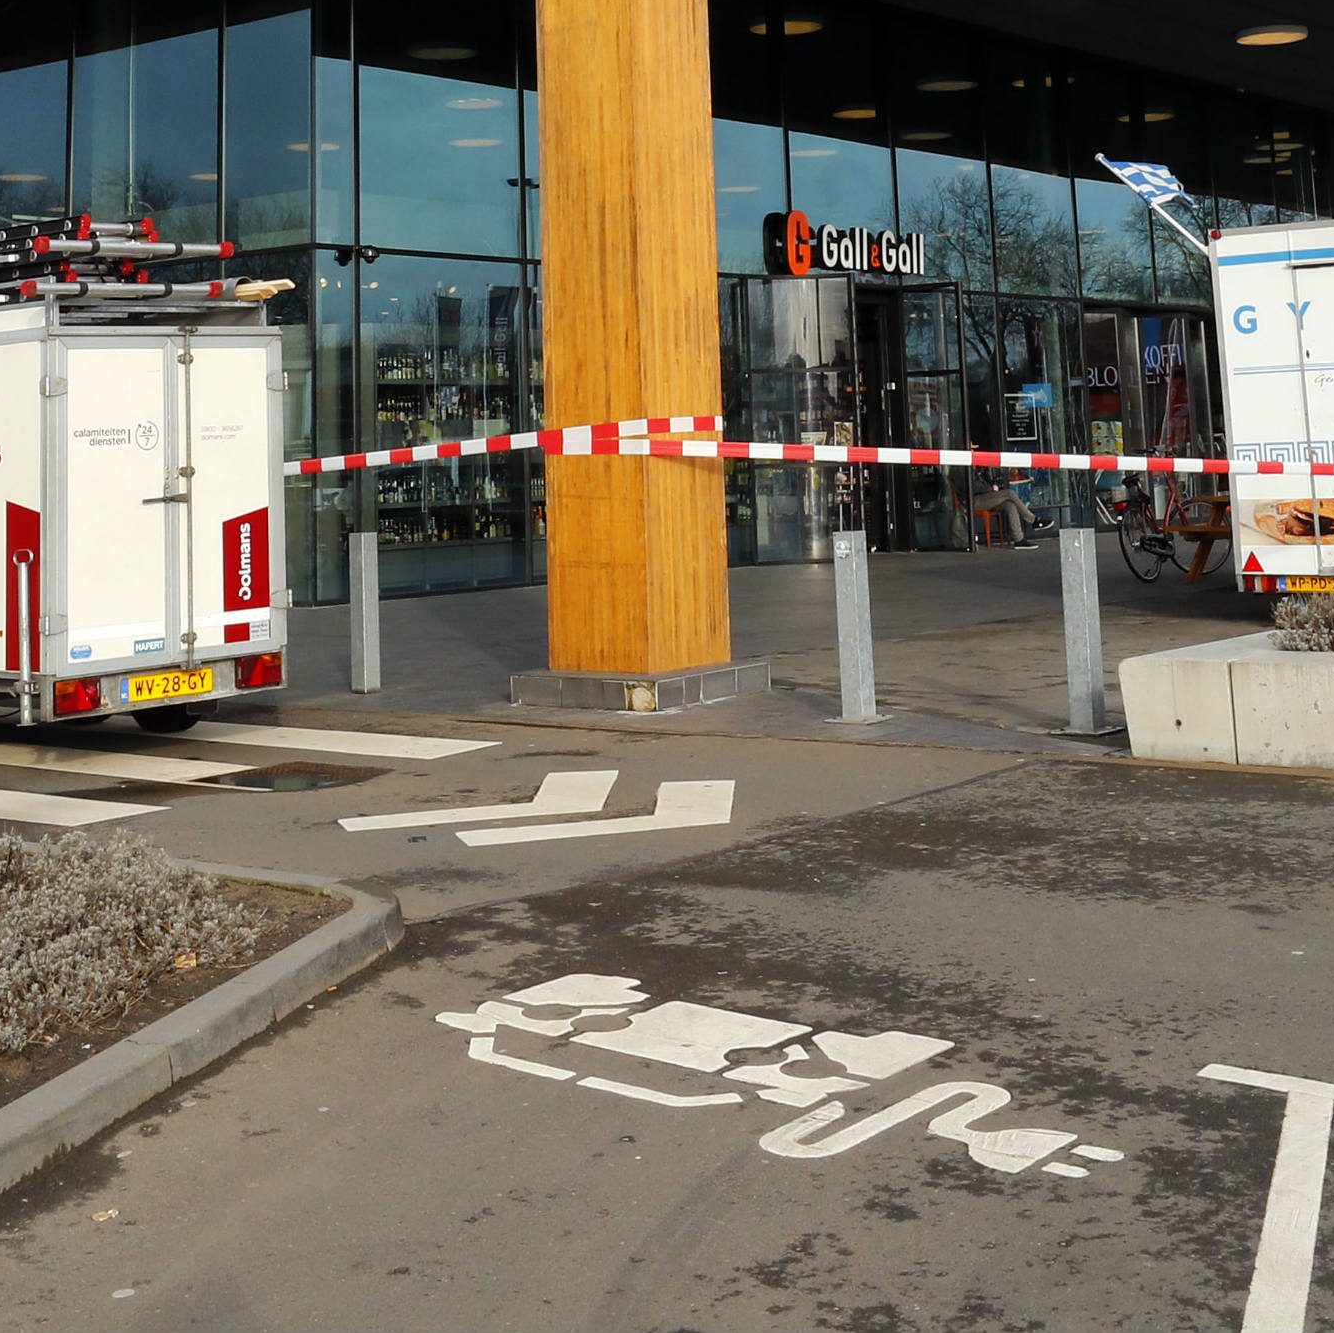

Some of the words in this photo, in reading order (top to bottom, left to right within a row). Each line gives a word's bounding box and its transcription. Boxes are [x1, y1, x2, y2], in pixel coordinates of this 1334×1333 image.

[822, 224, 868, 270] Gall
[882, 230, 925, 275] Gall
[74, 428, 126, 438] calamiteiten
[89, 437, 126, 446] diensten
[135, 640, 164, 652] HAPERT
[135, 672, 207, 697] WV-28-GY
